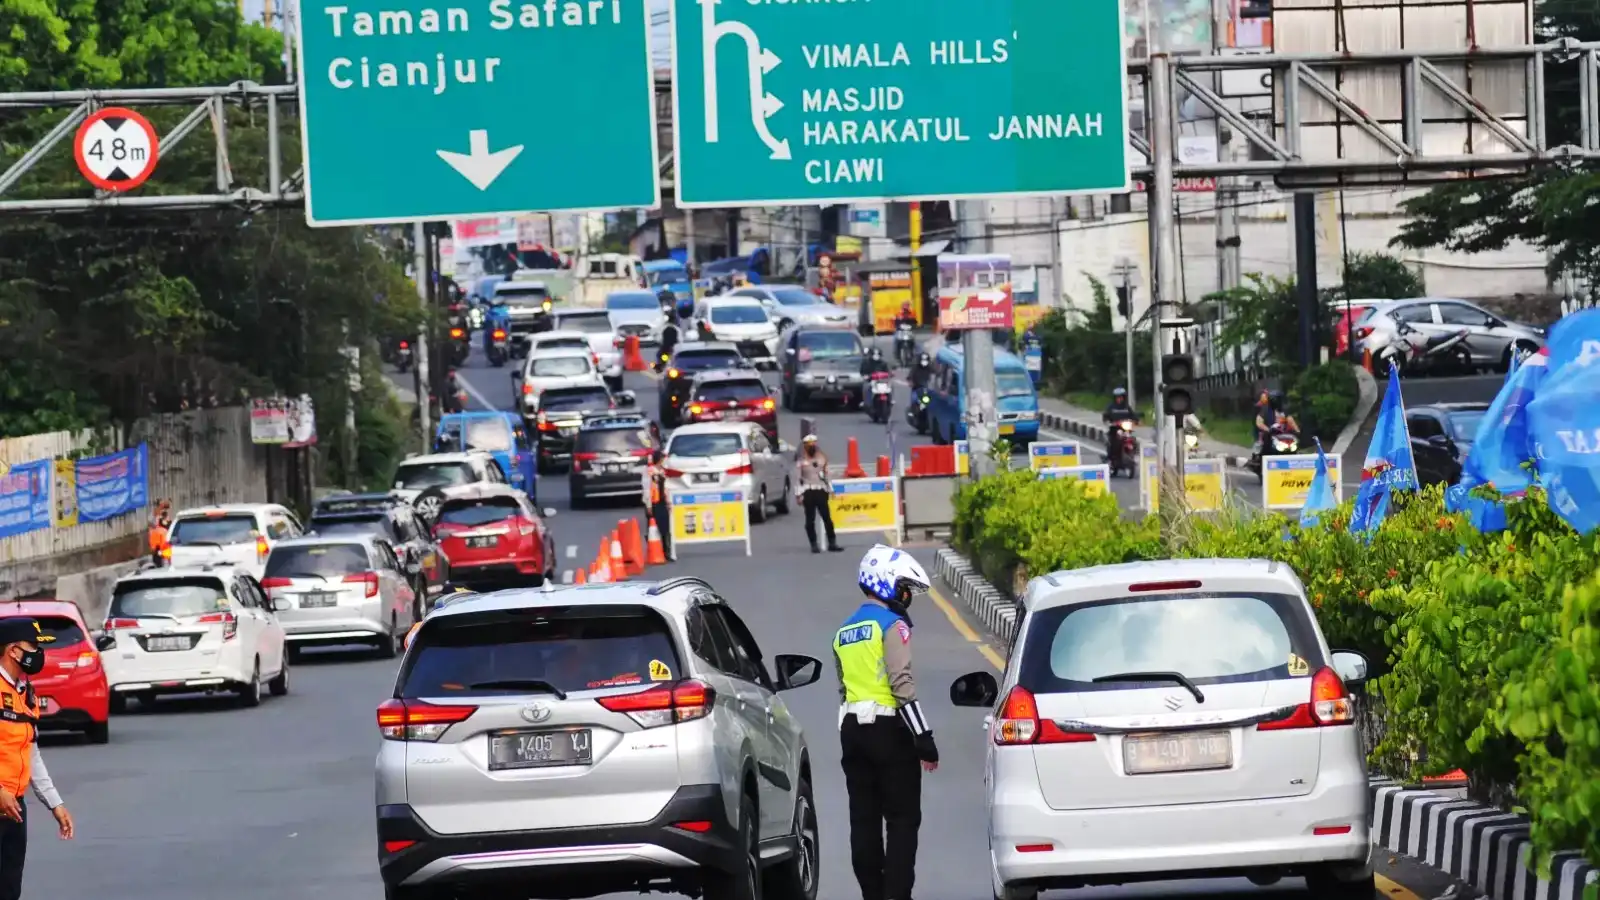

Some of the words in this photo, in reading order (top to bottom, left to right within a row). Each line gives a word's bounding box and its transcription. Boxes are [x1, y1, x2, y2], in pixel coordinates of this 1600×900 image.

[325, 6, 469, 37] Taman
[489, 0, 621, 30] Safari
[802, 43, 911, 69] VIMALA
[930, 38, 1009, 65] HILLS
[328, 53, 501, 95] Cianjur
[802, 87, 905, 113] MASJID
[803, 118, 970, 145] HARAKATUL
[988, 113, 1102, 141] JANNAH
[804, 158, 884, 184] CIAWI
